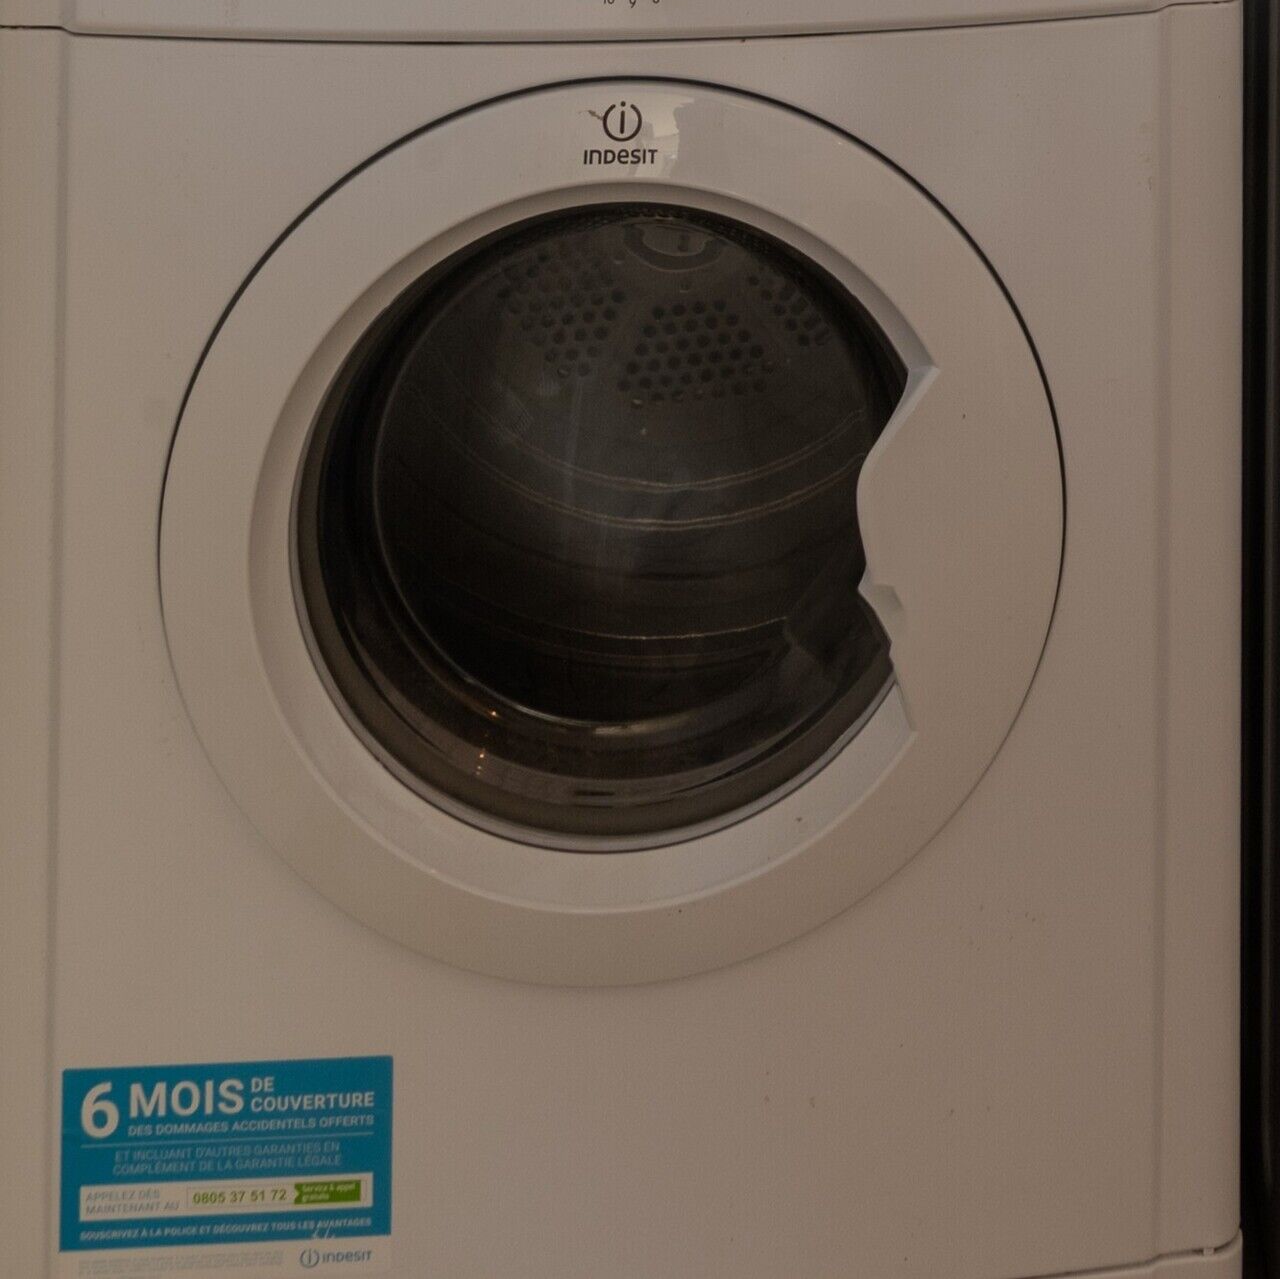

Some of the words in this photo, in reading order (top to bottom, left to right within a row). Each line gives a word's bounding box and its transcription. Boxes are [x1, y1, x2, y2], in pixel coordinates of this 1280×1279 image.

[251, 1076, 275, 1093] DE
[81, 1081, 120, 1138] 6
[129, 1078, 245, 1118] MOIS
[250, 1091, 375, 1113] COUVERTURE
[128, 1124, 153, 1137] DES
[155, 1120, 229, 1136] DOMMAGES
[232, 1116, 317, 1132] ACCIDENTELS
[319, 1114, 375, 1128] OFFERTS
[192, 1191, 226, 1205] 0805
[230, 1191, 246, 1203] 37
[250, 1189, 265, 1202] 51
[271, 1189, 287, 1201] 72
